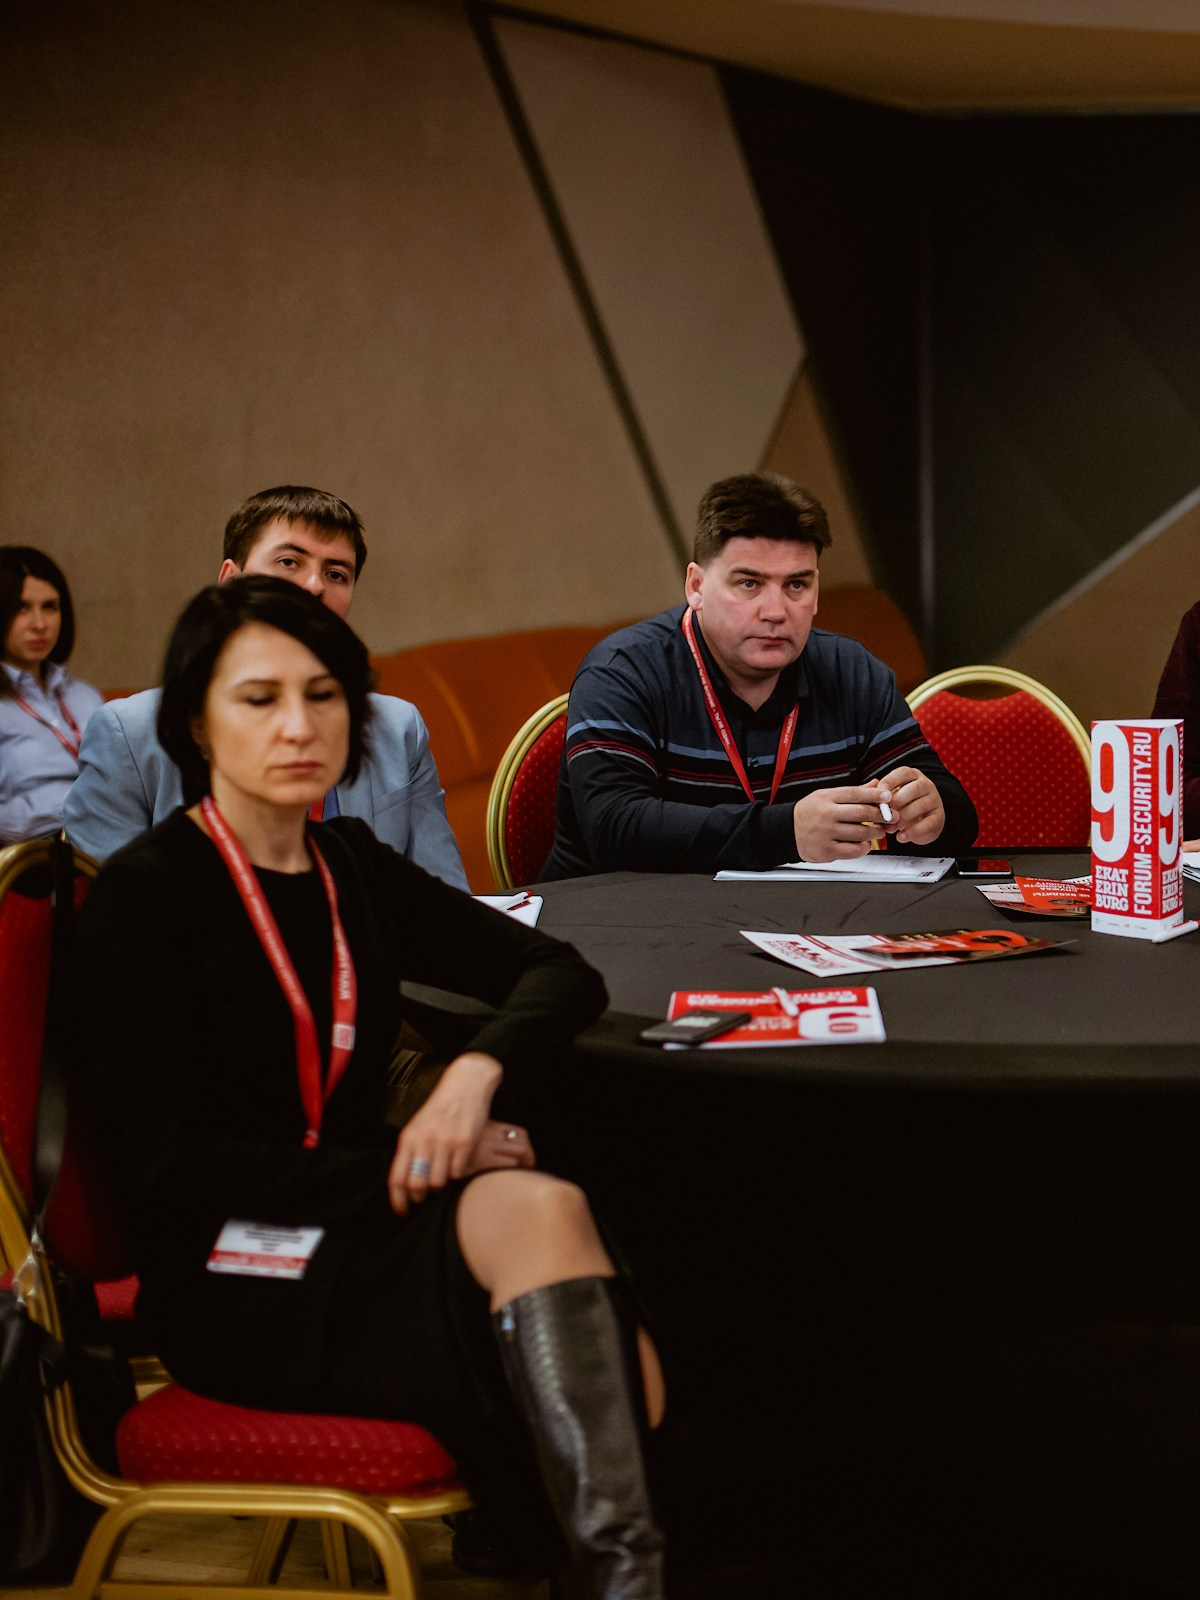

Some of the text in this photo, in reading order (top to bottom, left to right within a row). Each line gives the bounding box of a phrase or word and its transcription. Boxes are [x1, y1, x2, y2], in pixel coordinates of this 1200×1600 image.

[1092, 722, 1131, 863] 9
[1133, 731, 1153, 916] FORUM-SECURITY.RU
[1159, 725, 1179, 866] 9
[1095, 865, 1129, 883] EKAT
[1095, 879, 1129, 898] ERIN
[1095, 893, 1129, 912] BURG
